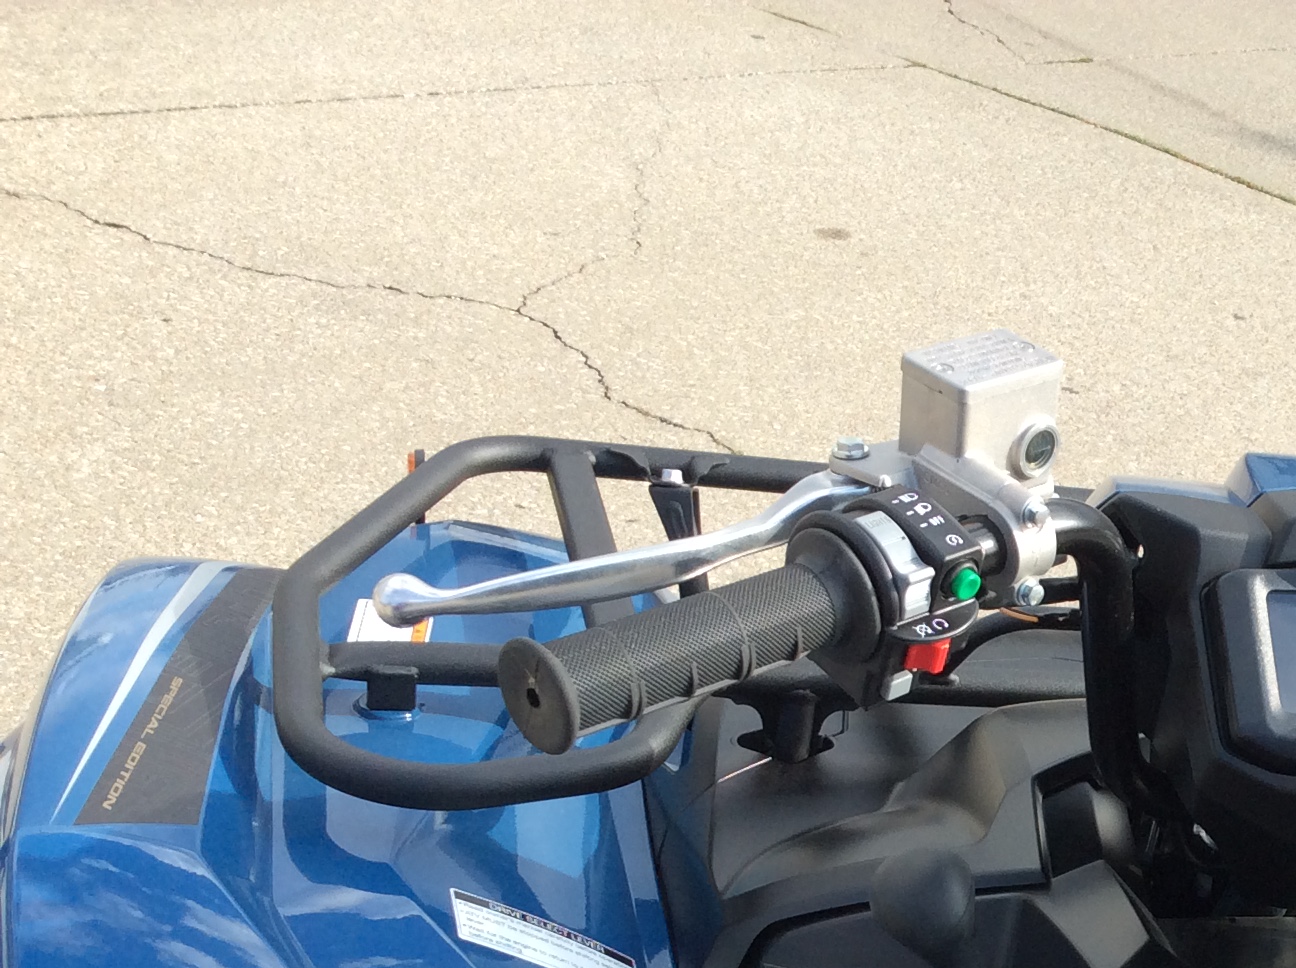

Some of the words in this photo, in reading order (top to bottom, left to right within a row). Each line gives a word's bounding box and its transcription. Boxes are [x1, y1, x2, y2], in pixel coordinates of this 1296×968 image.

[141, 676, 183, 738] SPECIAL
[102, 741, 146, 810] EDITION
[489, 901, 524, 920] DRIVE
[526, 914, 568, 936] SELECT
